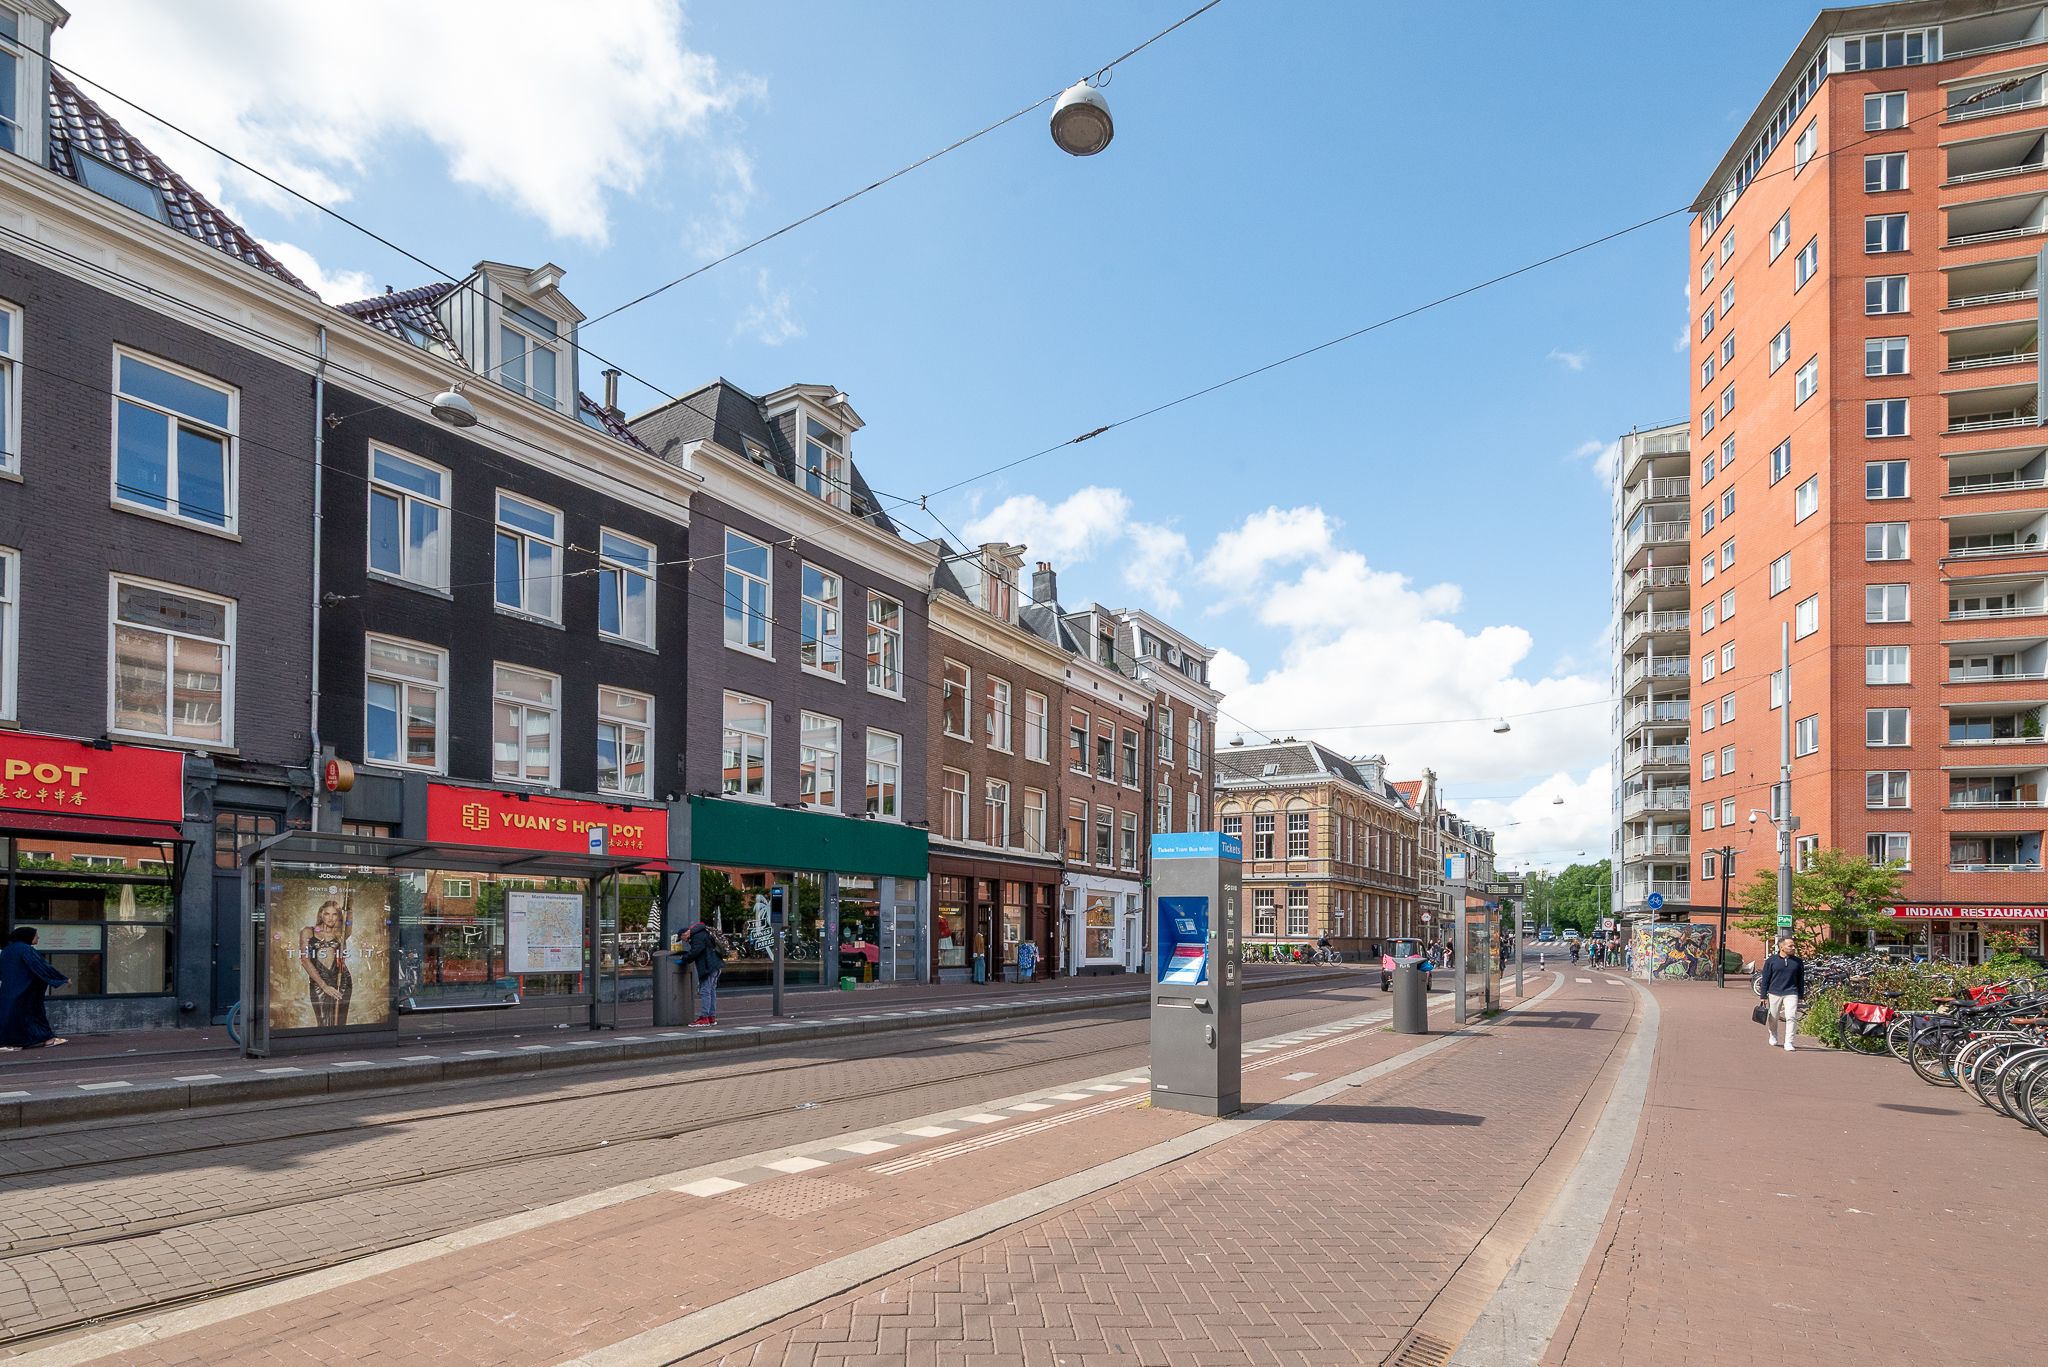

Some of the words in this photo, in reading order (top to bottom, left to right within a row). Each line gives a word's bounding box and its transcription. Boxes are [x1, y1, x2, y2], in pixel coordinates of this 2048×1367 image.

[5, 759, 89, 787] POT
[612, 823, 645, 839] POT
[1221, 841, 1241, 855] Tickets
[1905, 907, 1953, 917] INDIAN
[286, 948, 328, 960] THIS
[335, 948, 352, 959] IS
[359, 948, 375, 959] IT
